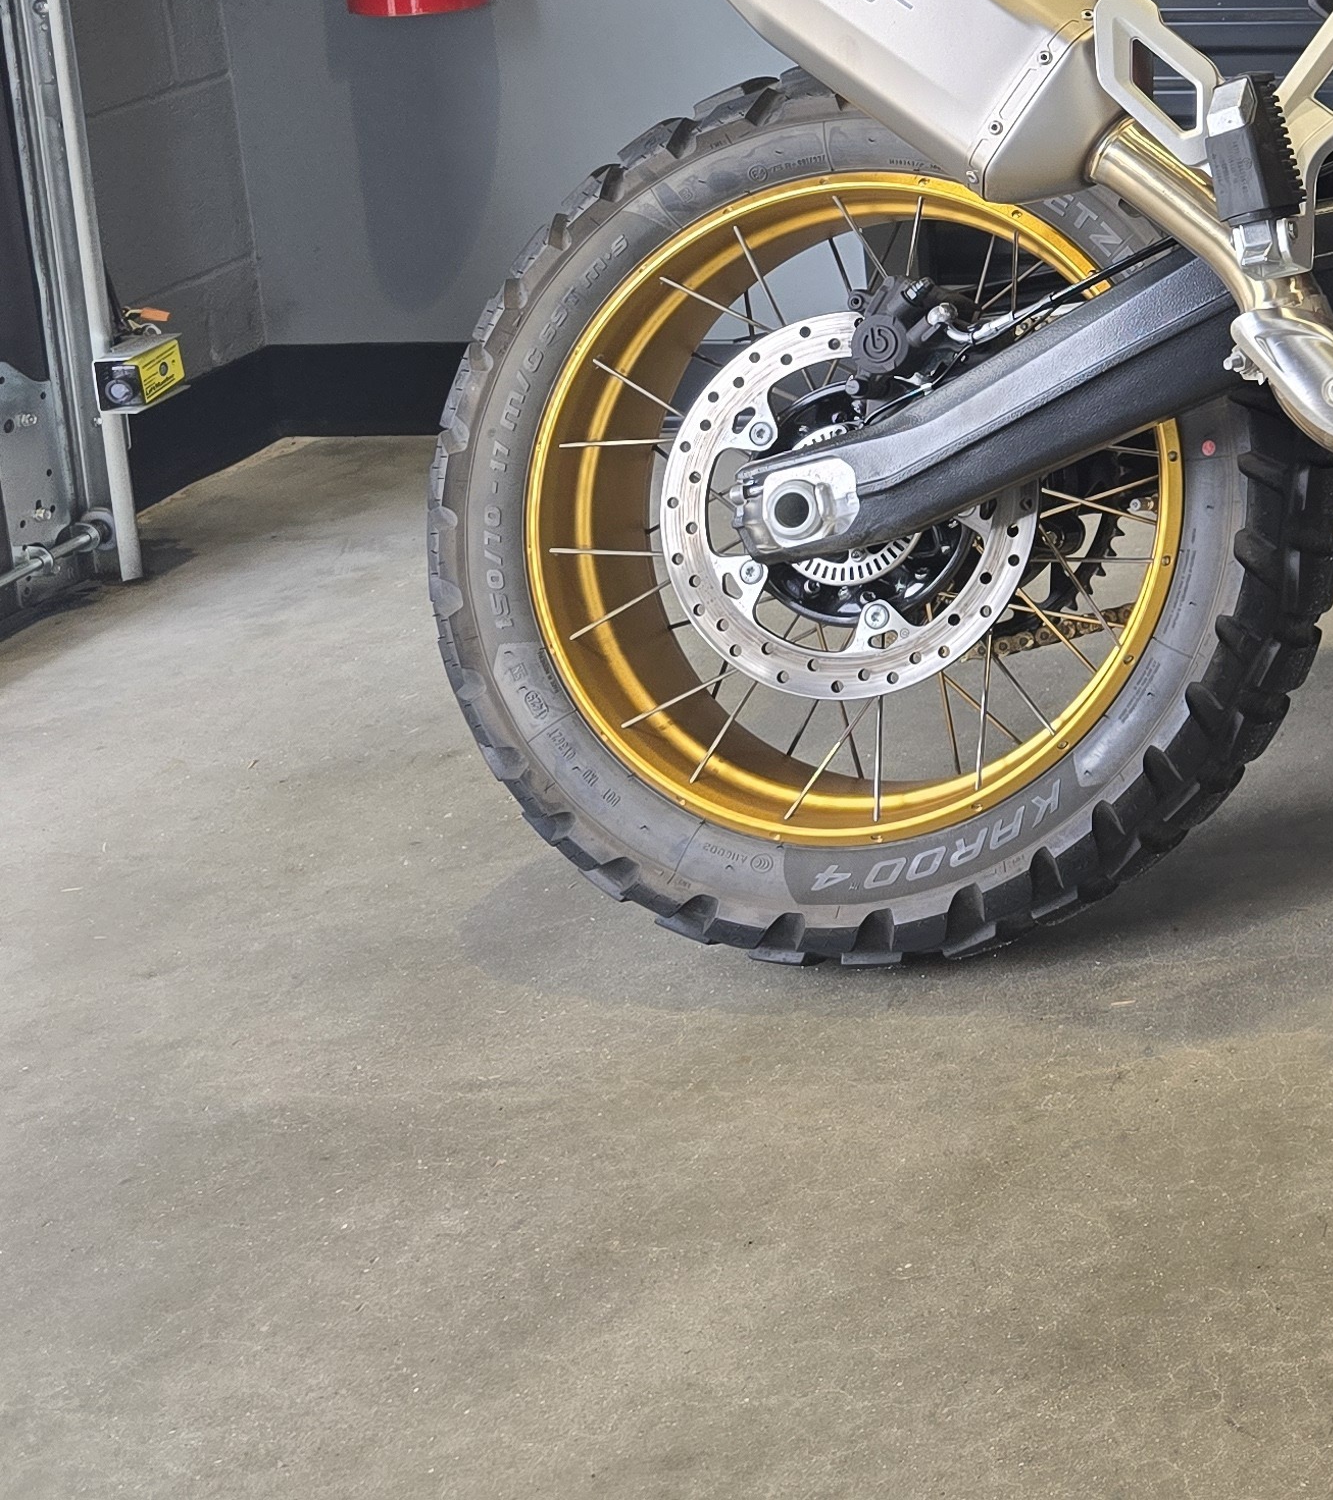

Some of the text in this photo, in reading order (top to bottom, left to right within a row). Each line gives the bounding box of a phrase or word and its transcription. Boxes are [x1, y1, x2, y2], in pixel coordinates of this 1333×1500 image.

[483, 504, 514, 631] 150/70
[500, 348, 546, 431] M/C
[810, 778, 1061, 892] KAROO 4
